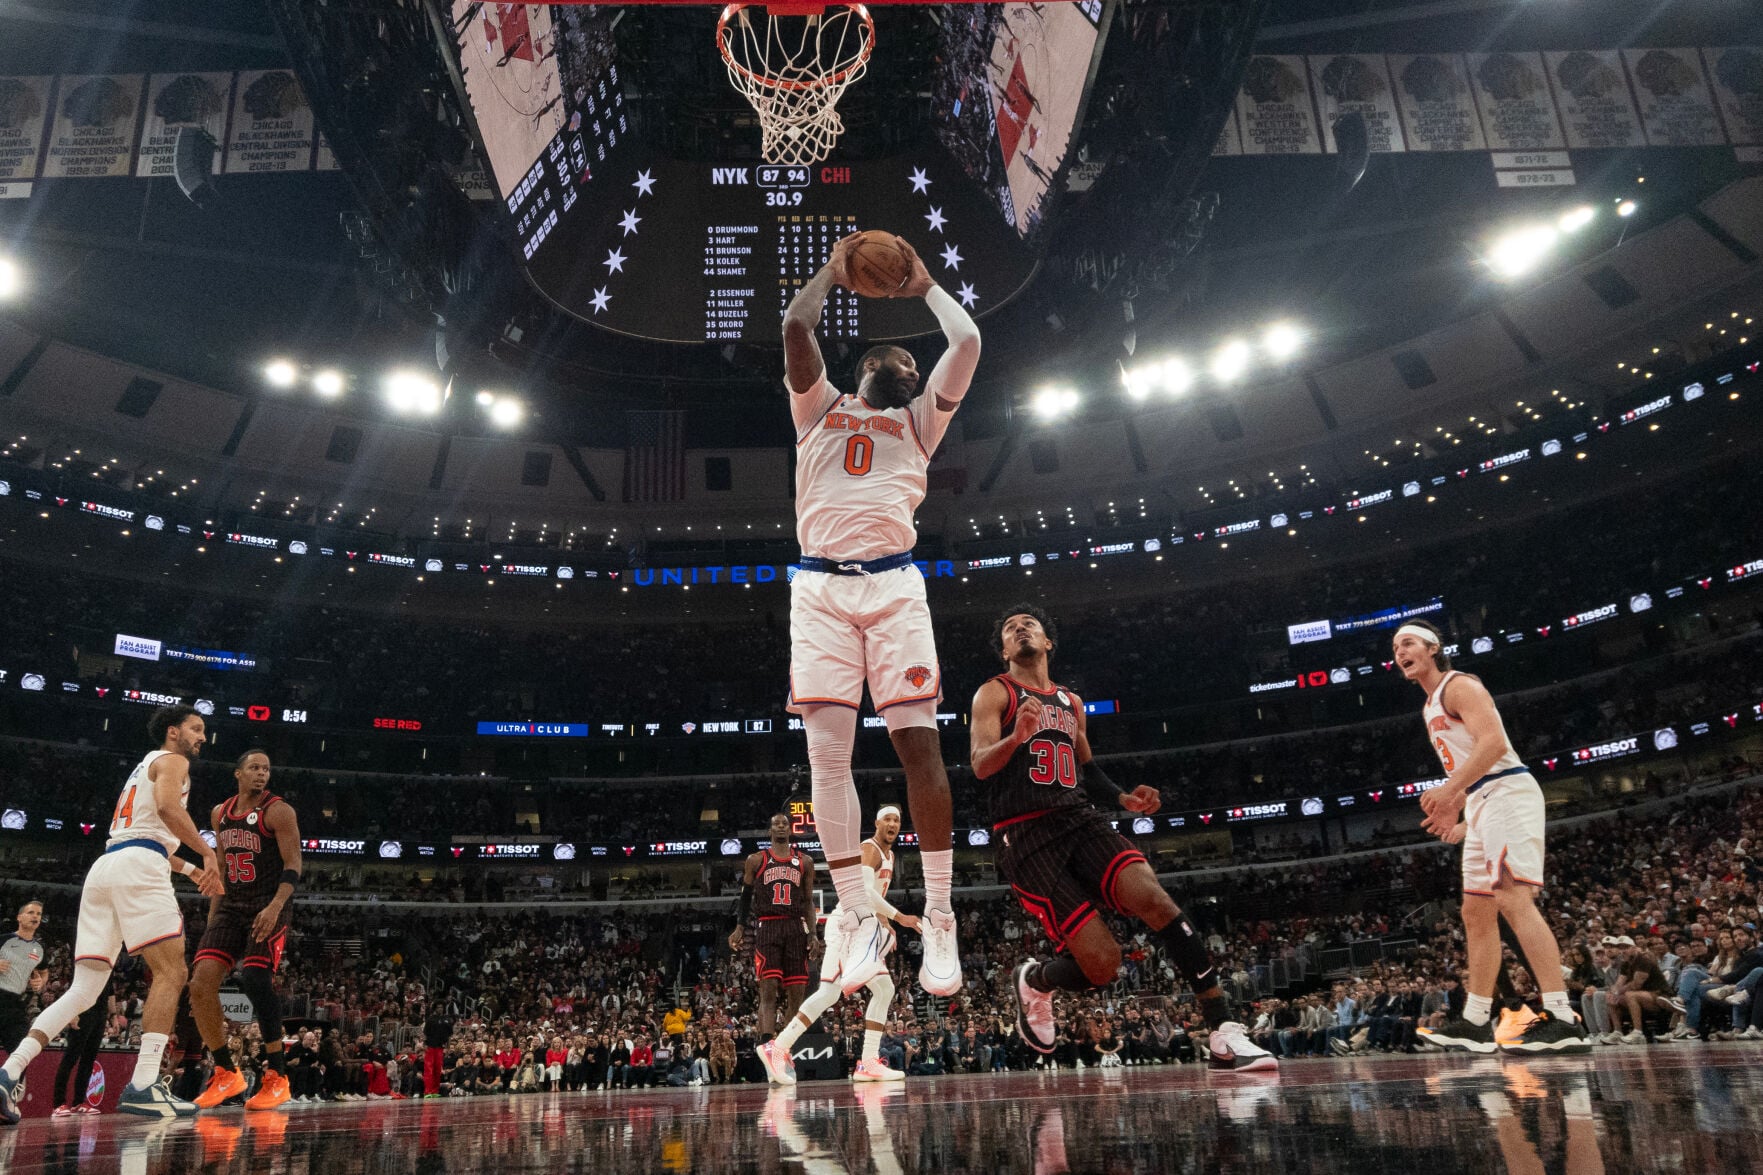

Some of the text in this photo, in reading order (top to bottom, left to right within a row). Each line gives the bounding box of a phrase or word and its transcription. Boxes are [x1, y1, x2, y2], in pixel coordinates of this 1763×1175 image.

[252, 121, 293, 130] CHICAGO
[239, 131, 304, 140] BLACKHAWKS
[231, 140, 310, 150] CENTRAL DIVISION
[241, 151, 296, 160] CHAMPIONS
[712, 168, 850, 184] NYK 87 94 CHI
[766, 192, 802, 206] 30.9
[847, 225, 858, 233] 14
[1634, 395, 1671, 416] TISSOT
[823, 412, 904, 440] NEW YORK
[844, 434, 874, 476] 0
[1493, 449, 1530, 465] TISSOT
[1359, 490, 1392, 504] TISSOT
[96, 504, 135, 519] TISSOT
[1227, 519, 1260, 532] TISSOT
[241, 534, 278, 546] TISSOT
[1101, 543, 1134, 553] TISSOT
[381, 554, 415, 565] TISSOT
[980, 557, 1011, 566] TISSOT
[514, 566, 548, 574] TISSOT
[633, 566, 777, 586] UNITED
[1403, 603, 1442, 618] ASSISTANCE
[1577, 604, 1617, 622] TISSOT
[120, 646, 156, 656] PROGRAM
[136, 642, 156, 650] ASSIST
[166, 650, 182, 658] TEXT
[1250, 680, 1297, 692] ticketmaster
[140, 692, 182, 705] TISSOT
[282, 709, 307, 723] 8:54
[374, 718, 422, 730] SEE RED
[703, 722, 739, 733] NEW YORK
[753, 721, 764, 731] 87
[864, 717, 888, 728] CHICA
[1038, 704, 1079, 750] ICAGO
[496, 724, 570, 734] ULTRA CLUB
[1589, 738, 1637, 757] TISSOT
[1030, 739, 1078, 788] 30
[1242, 803, 1286, 816] TISSOT
[220, 828, 261, 854] HICAGO
[318, 840, 365, 850] TISSOT
[665, 842, 708, 851] TISSOT
[496, 845, 540, 854] TISSOT
[764, 866, 801, 887] CHICAGO
[772, 882, 792, 905] 11
[222, 1003, 250, 1014] ocate
